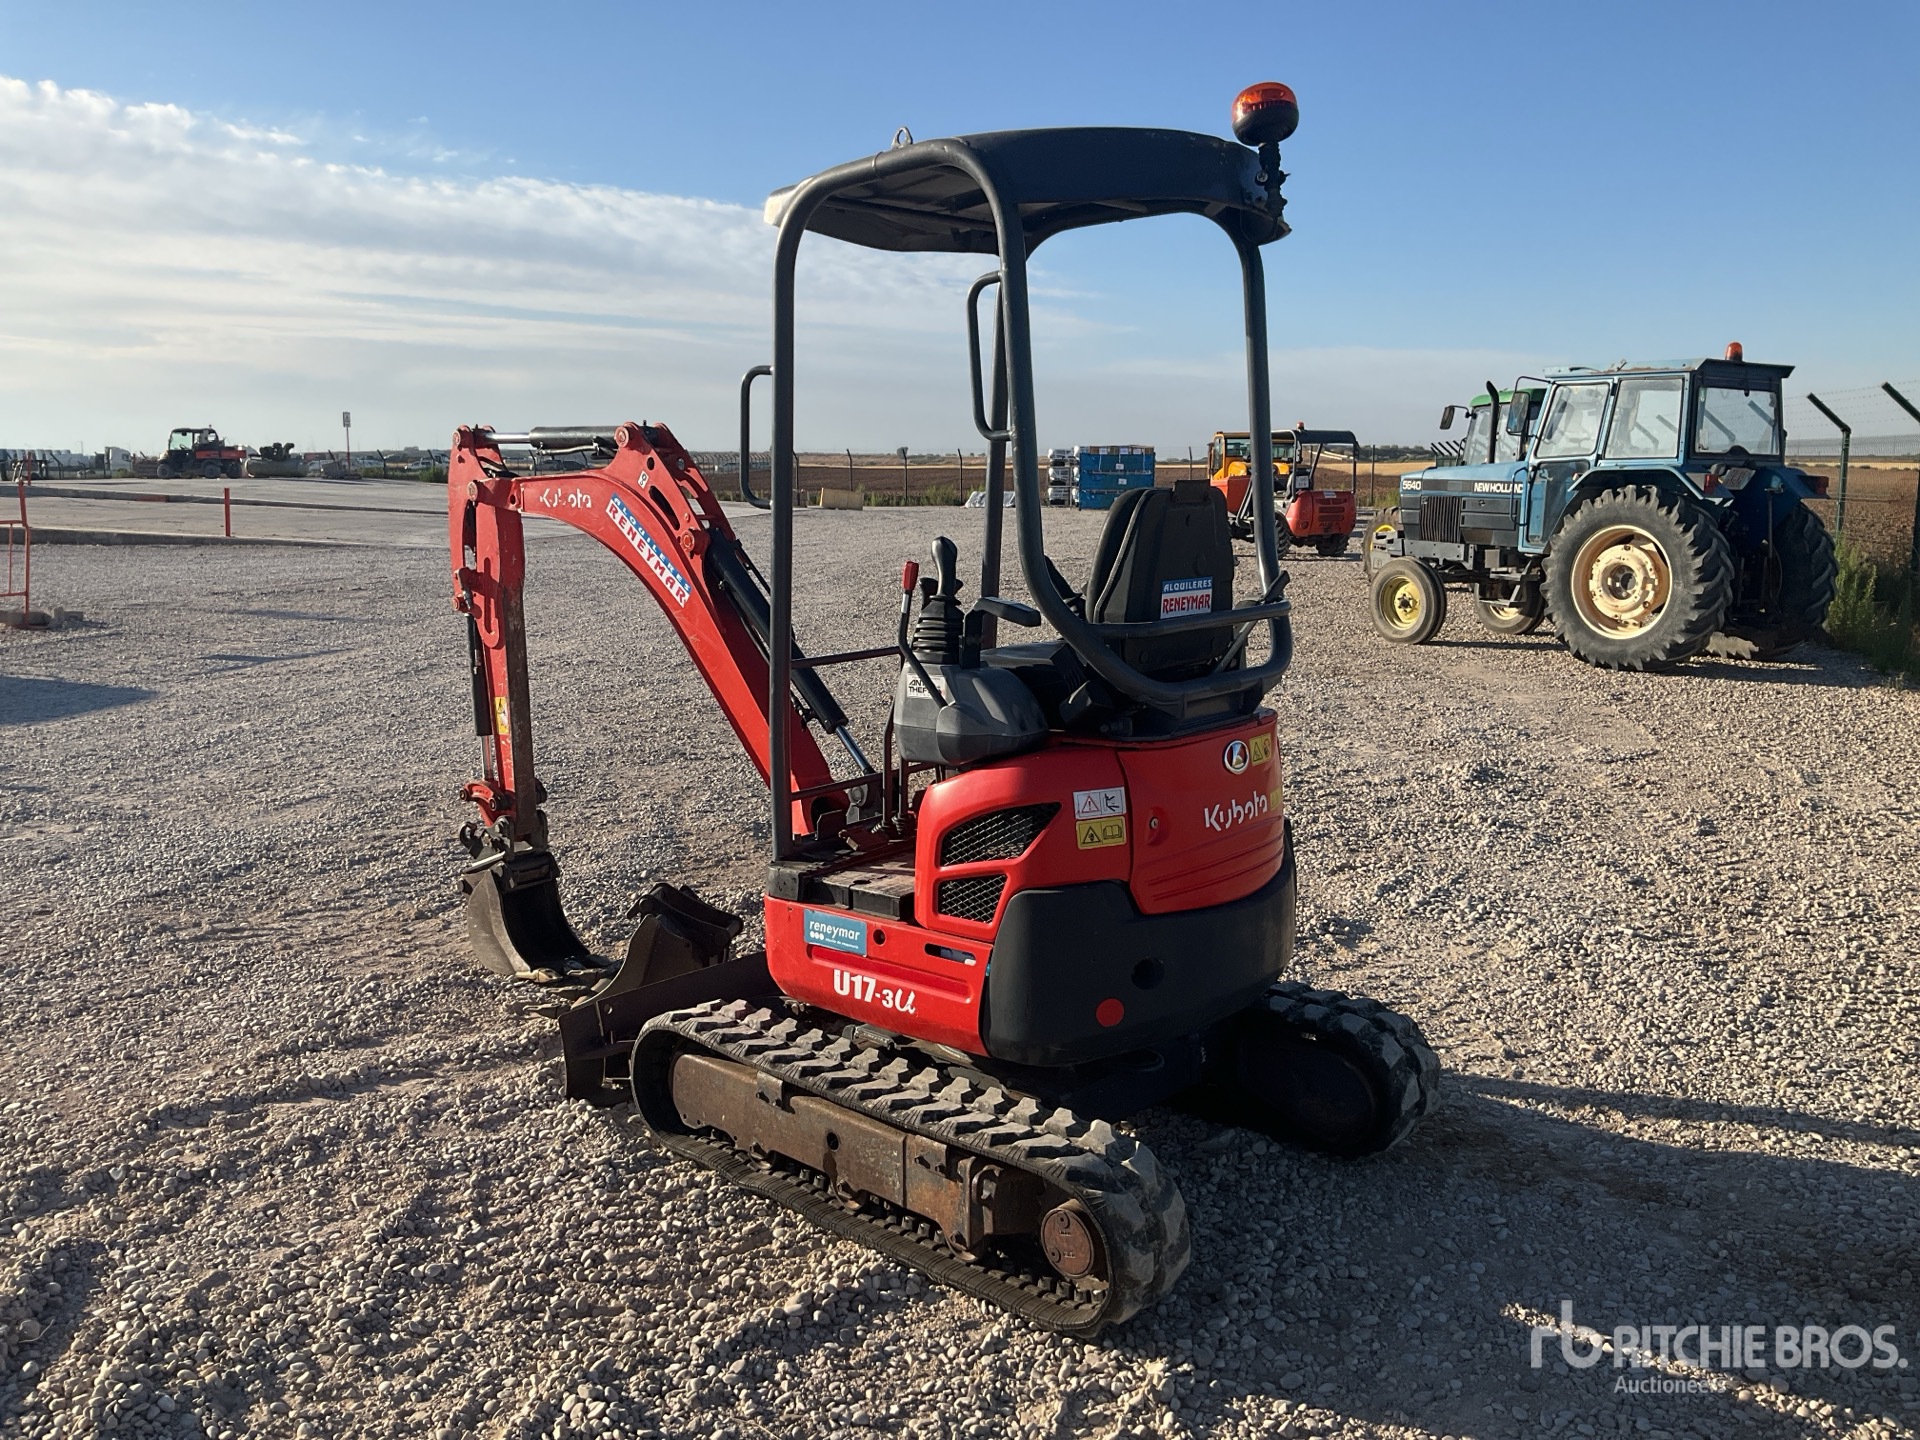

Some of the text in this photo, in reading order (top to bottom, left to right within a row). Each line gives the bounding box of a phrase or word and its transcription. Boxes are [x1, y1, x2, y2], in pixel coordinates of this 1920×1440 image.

[1473, 482, 1490, 492] NEW
[608, 504, 686, 603] RENEYMAR
[1163, 579, 1212, 592] ALQUILERES
[1162, 593, 1211, 614] RENEYMAR
[1204, 790, 1268, 831] Kubota
[809, 921, 860, 940] reneymar
